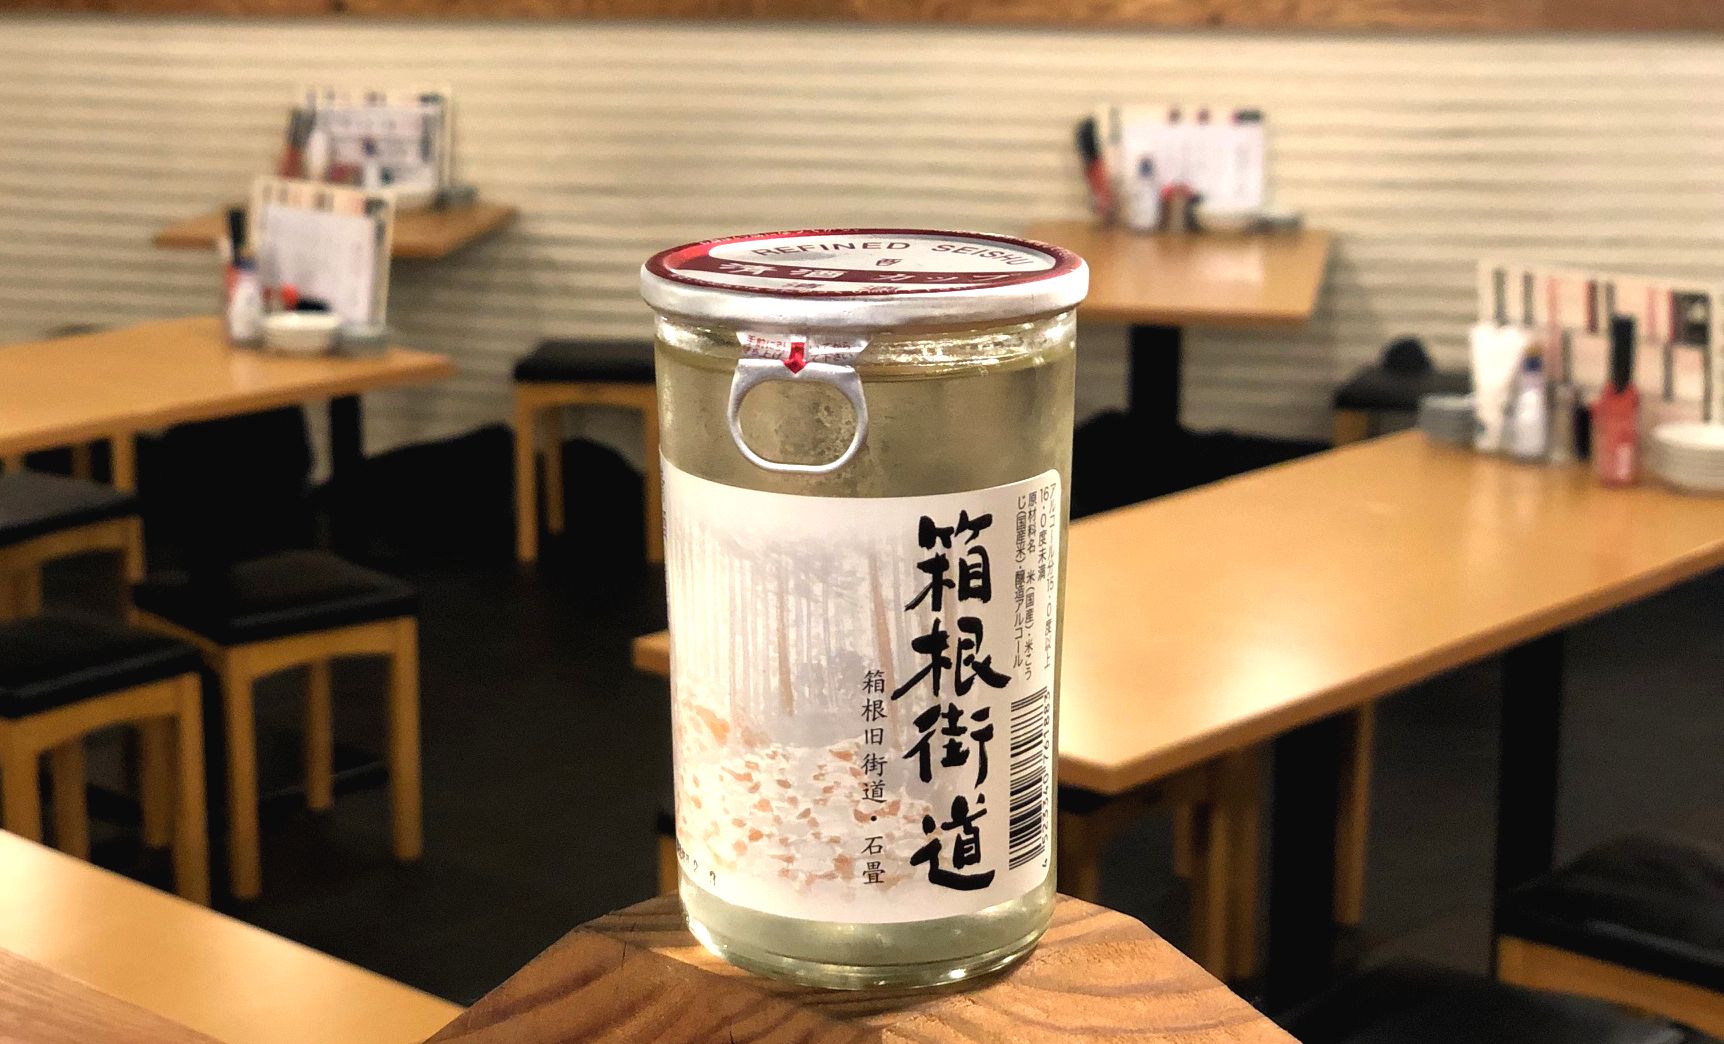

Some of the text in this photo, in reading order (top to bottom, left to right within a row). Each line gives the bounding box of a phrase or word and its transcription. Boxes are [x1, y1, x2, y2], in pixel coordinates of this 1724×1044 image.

[752, 242, 1035, 265] REFINED SEISHU
[890, 509, 1011, 891] 箱根街道
